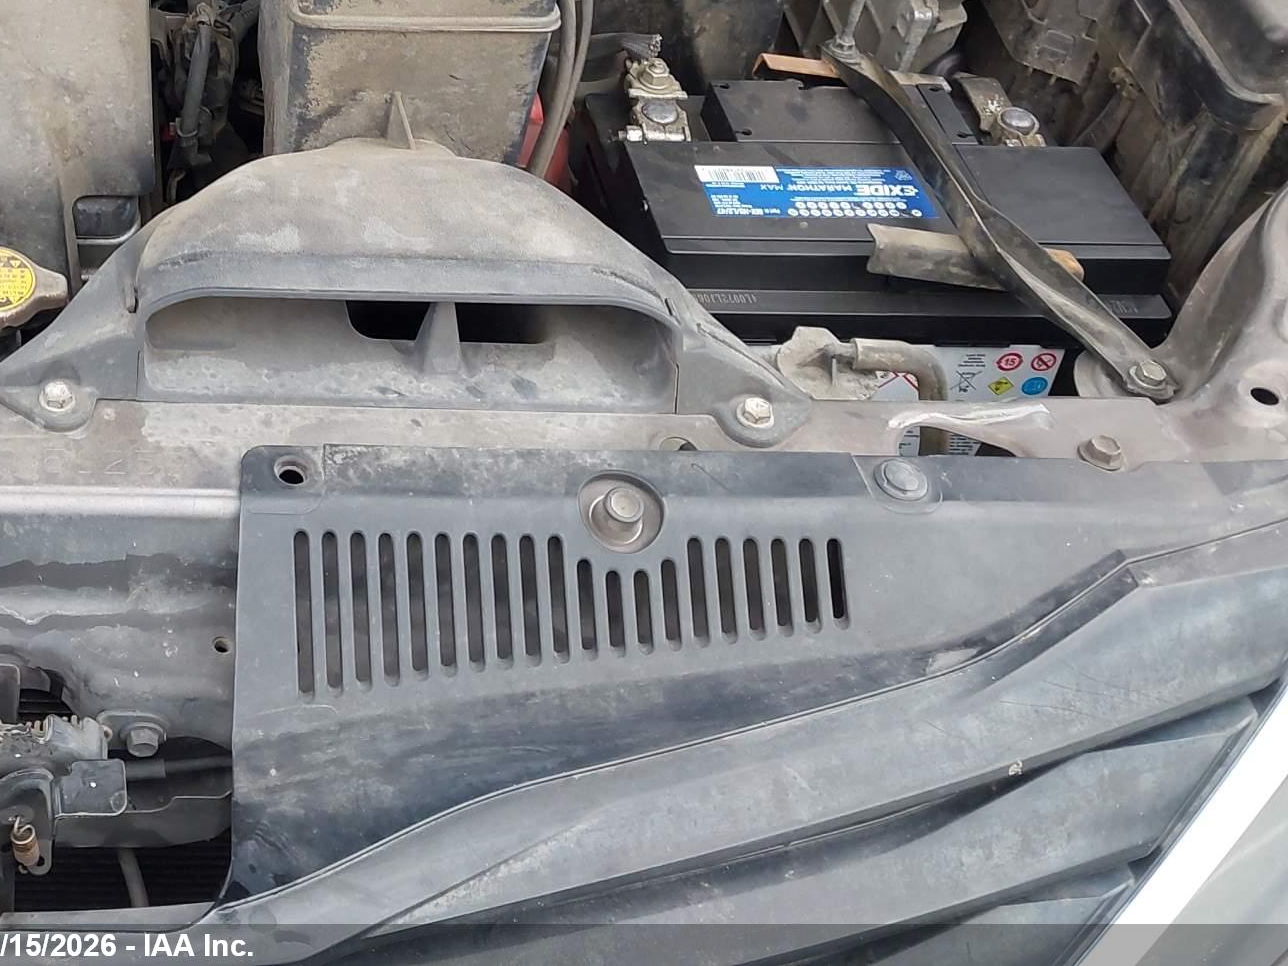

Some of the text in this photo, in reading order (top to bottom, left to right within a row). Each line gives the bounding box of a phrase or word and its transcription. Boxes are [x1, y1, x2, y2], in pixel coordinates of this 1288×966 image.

[760, 183, 919, 197] EXIDE MARATHON MAX
[1004, 357, 1016, 366] 15
